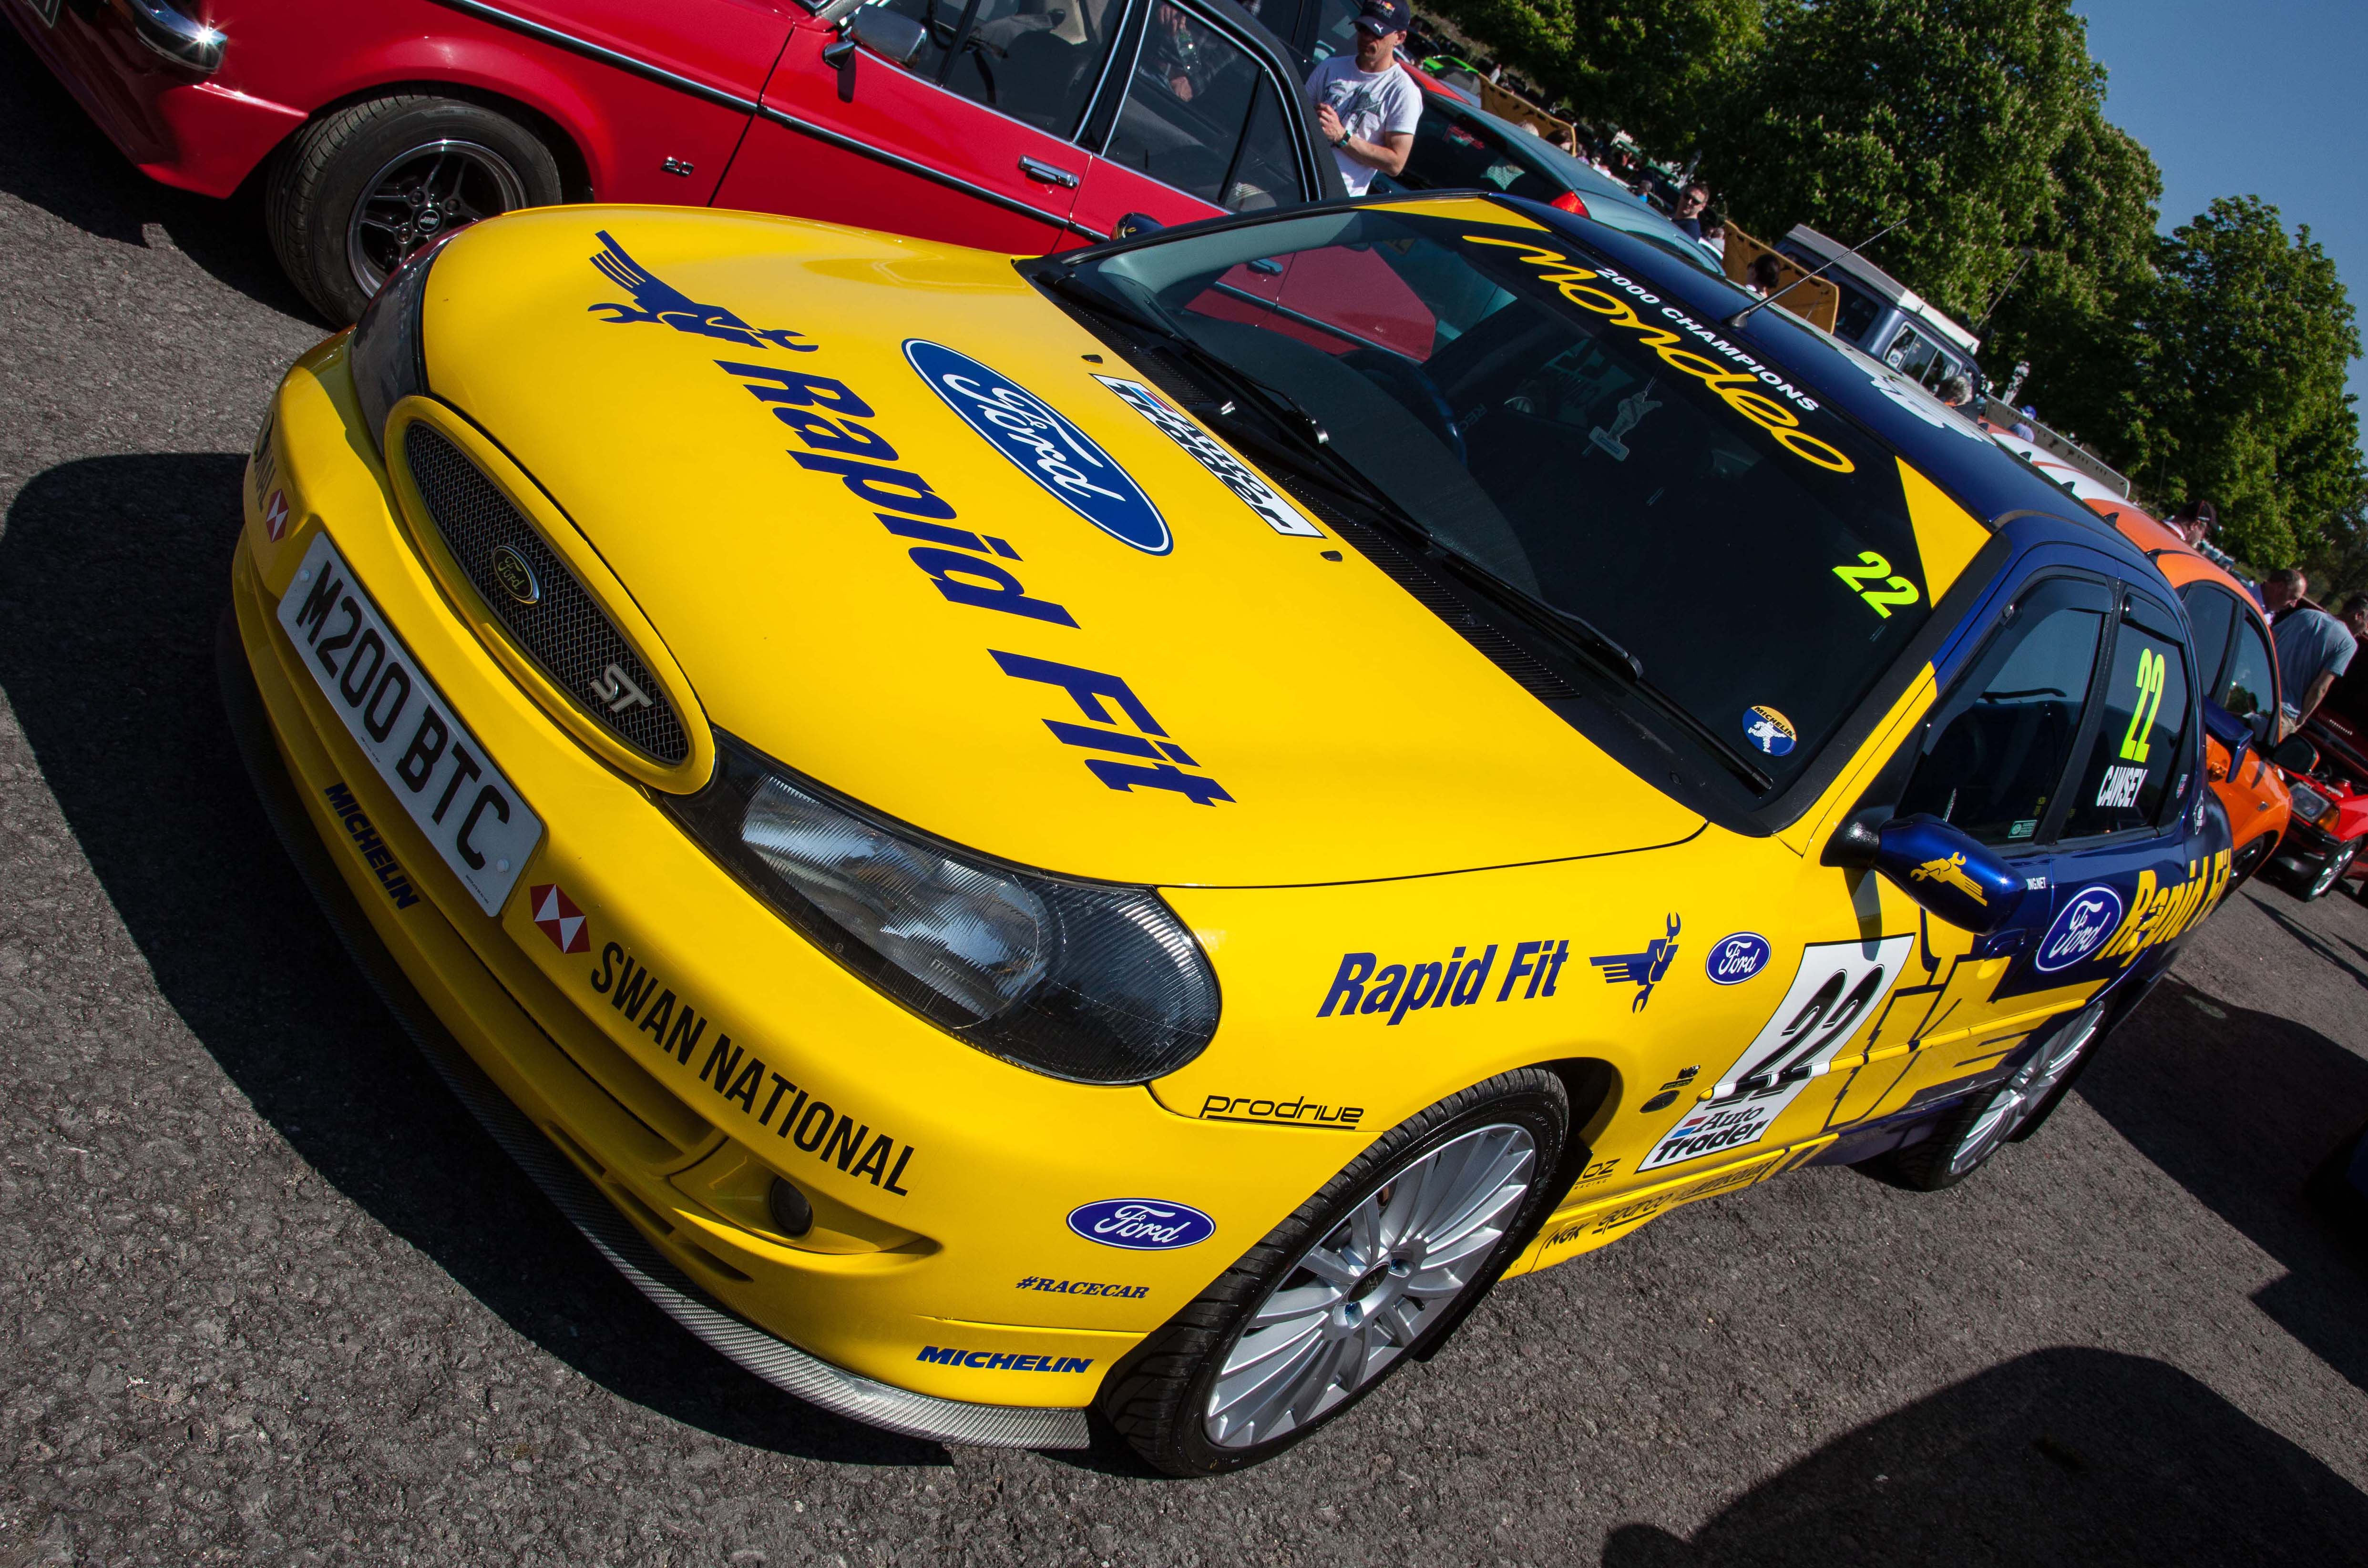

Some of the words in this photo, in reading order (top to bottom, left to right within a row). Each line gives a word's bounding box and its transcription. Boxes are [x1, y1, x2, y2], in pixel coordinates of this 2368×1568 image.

[1463, 235, 1855, 473] Mondeo
[1596, 267, 1660, 305] 2000
[1661, 306, 1819, 412] CHAMPIONS
[943, 374, 1126, 501] Ford
[1114, 383, 1293, 529] Trader
[498, 557, 524, 590] Ford
[714, 360, 1081, 629] Rapid
[986, 649, 1237, 807] Fit
[1832, 551, 1919, 619] 22
[297, 560, 411, 743] M200
[396, 704, 511, 871] BTC
[590, 664, 654, 713] ST
[2119, 648, 2165, 763] 22
[1754, 706, 1794, 737] MICHELIN
[2096, 765, 2149, 807] CAWSEY
[325, 783, 420, 910] MICHELIN
[2049, 901, 2110, 959] Ford
[2093, 856, 2209, 968] Rapid
[1317, 944, 1497, 1026] Rapid
[1497, 939, 1570, 1002] Fit
[1718, 941, 1761, 975] Ford
[1705, 964, 1885, 1110] 22
[591, 942, 707, 1065] SWAN
[699, 1033, 914, 1197] NATIONAL
[1199, 1095, 1363, 1125] prodrive
[1698, 1105, 1764, 1133] Auto
[1653, 1119, 1768, 1163] Trader
[1573, 1179, 1607, 1190] RACING
[1095, 1205, 1191, 1243] Ford
[1545, 1222, 1590, 1249] NGK
[1016, 1276, 1150, 1299] #RACECAR
[917, 1345, 1094, 1373] MICHELIN
